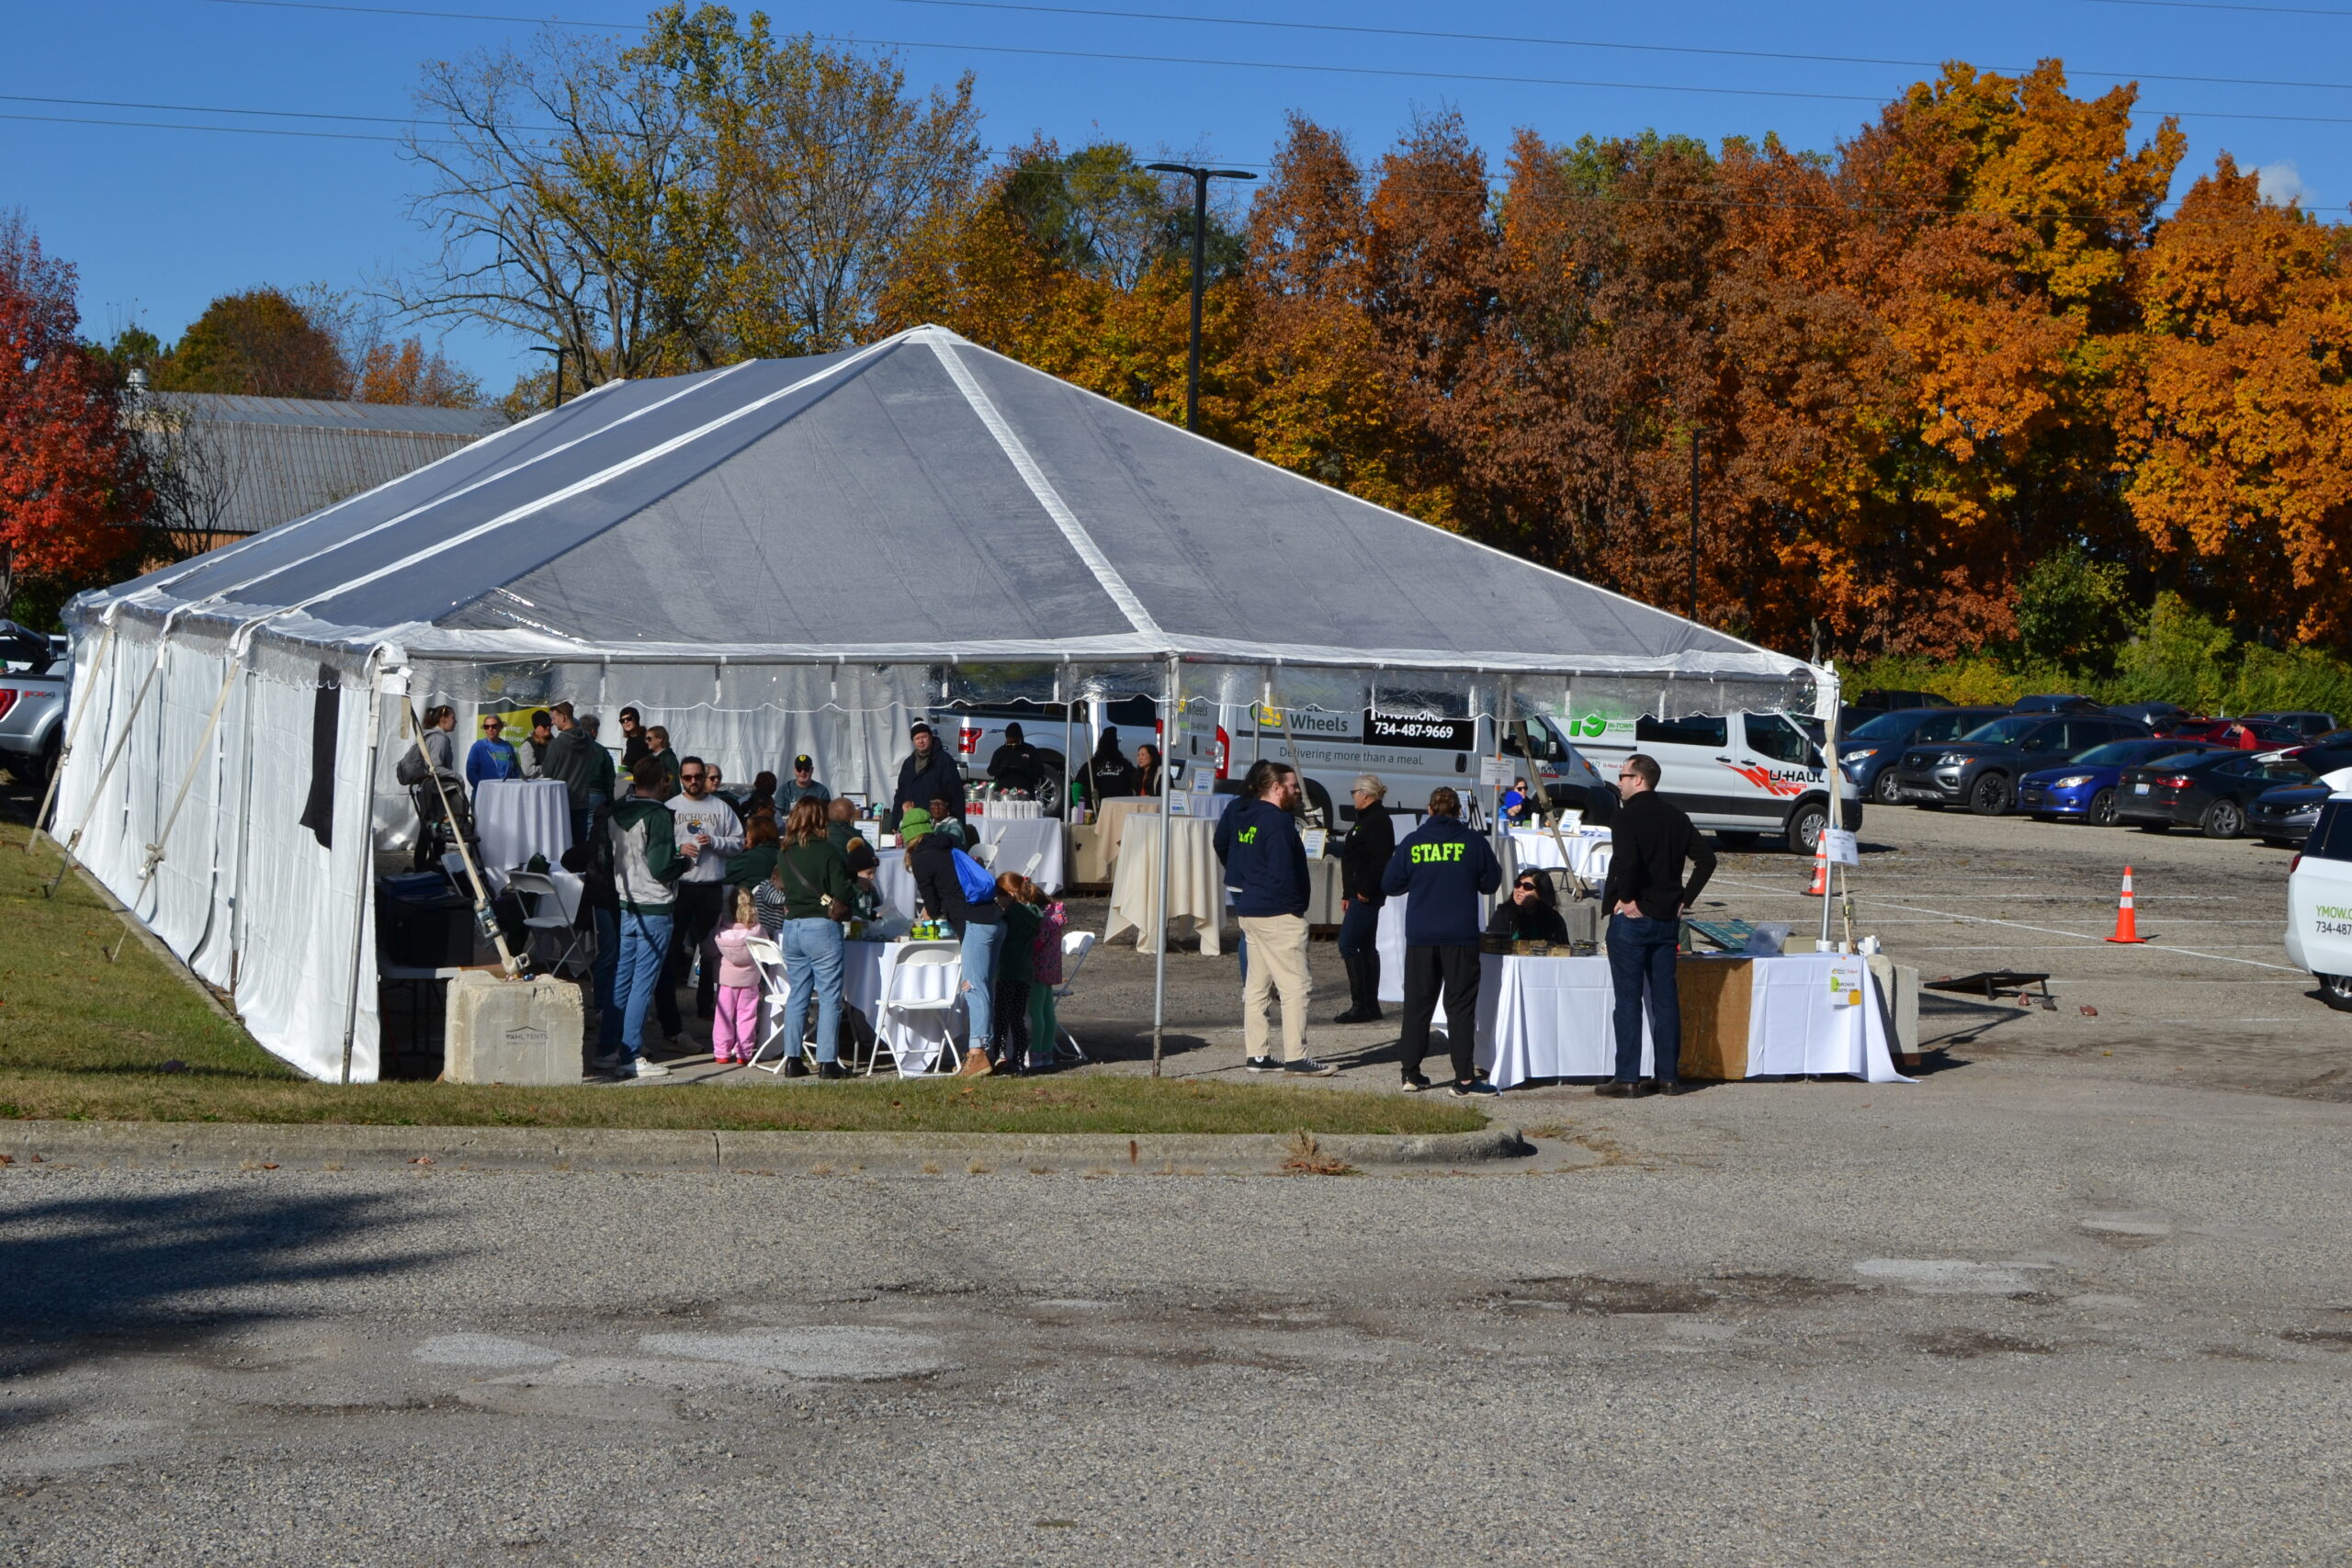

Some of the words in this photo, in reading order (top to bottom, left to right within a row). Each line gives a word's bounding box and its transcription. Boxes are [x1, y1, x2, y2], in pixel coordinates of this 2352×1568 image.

[1187, 705, 1208, 717] Wheels
[1290, 714, 1348, 732] Wheels
[1375, 722, 1453, 739] 734-487-9669
[1279, 746, 1331, 761] Delivering
[1334, 752, 1360, 761] more
[1363, 751, 1385, 762] than
[1770, 770, 1825, 783] U-HAUL
[675, 813, 720, 826] MICHIGAN
[1411, 843, 1465, 863] STAFF
